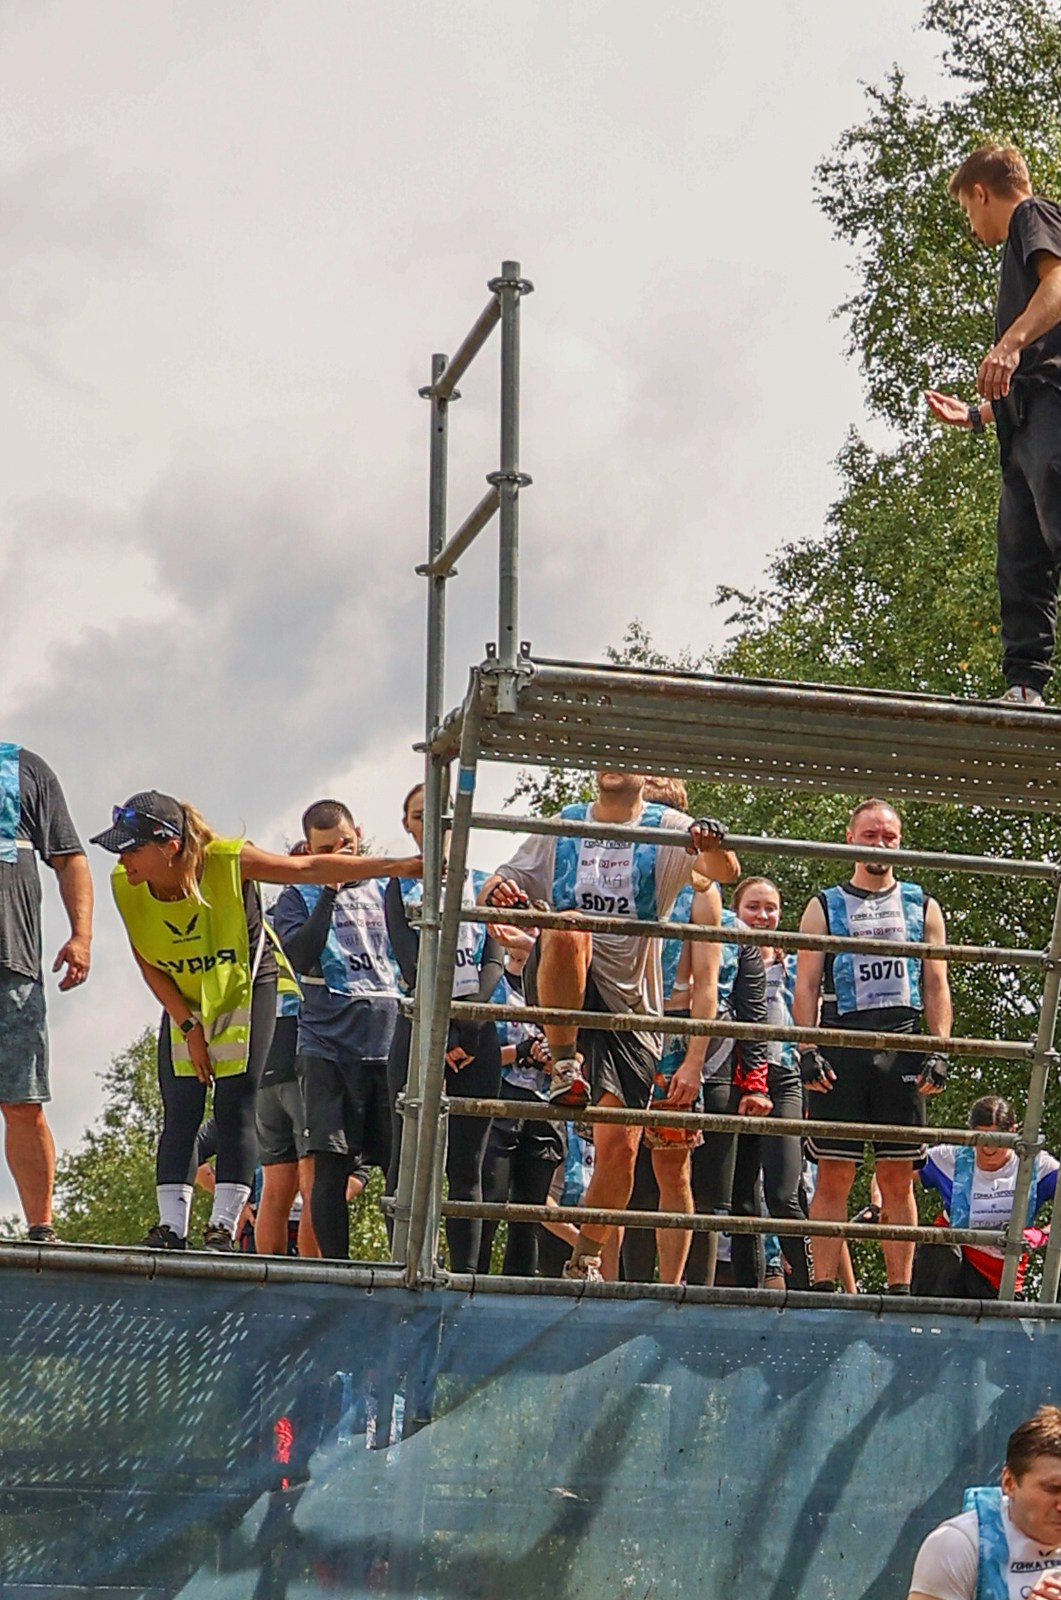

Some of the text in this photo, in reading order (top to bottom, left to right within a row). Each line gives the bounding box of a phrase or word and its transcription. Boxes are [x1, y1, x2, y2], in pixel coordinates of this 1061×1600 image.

[580, 892, 630, 914] 5072
[859, 960, 904, 981] 5070
[1010, 1561, 1042, 1571] ГОНКА
